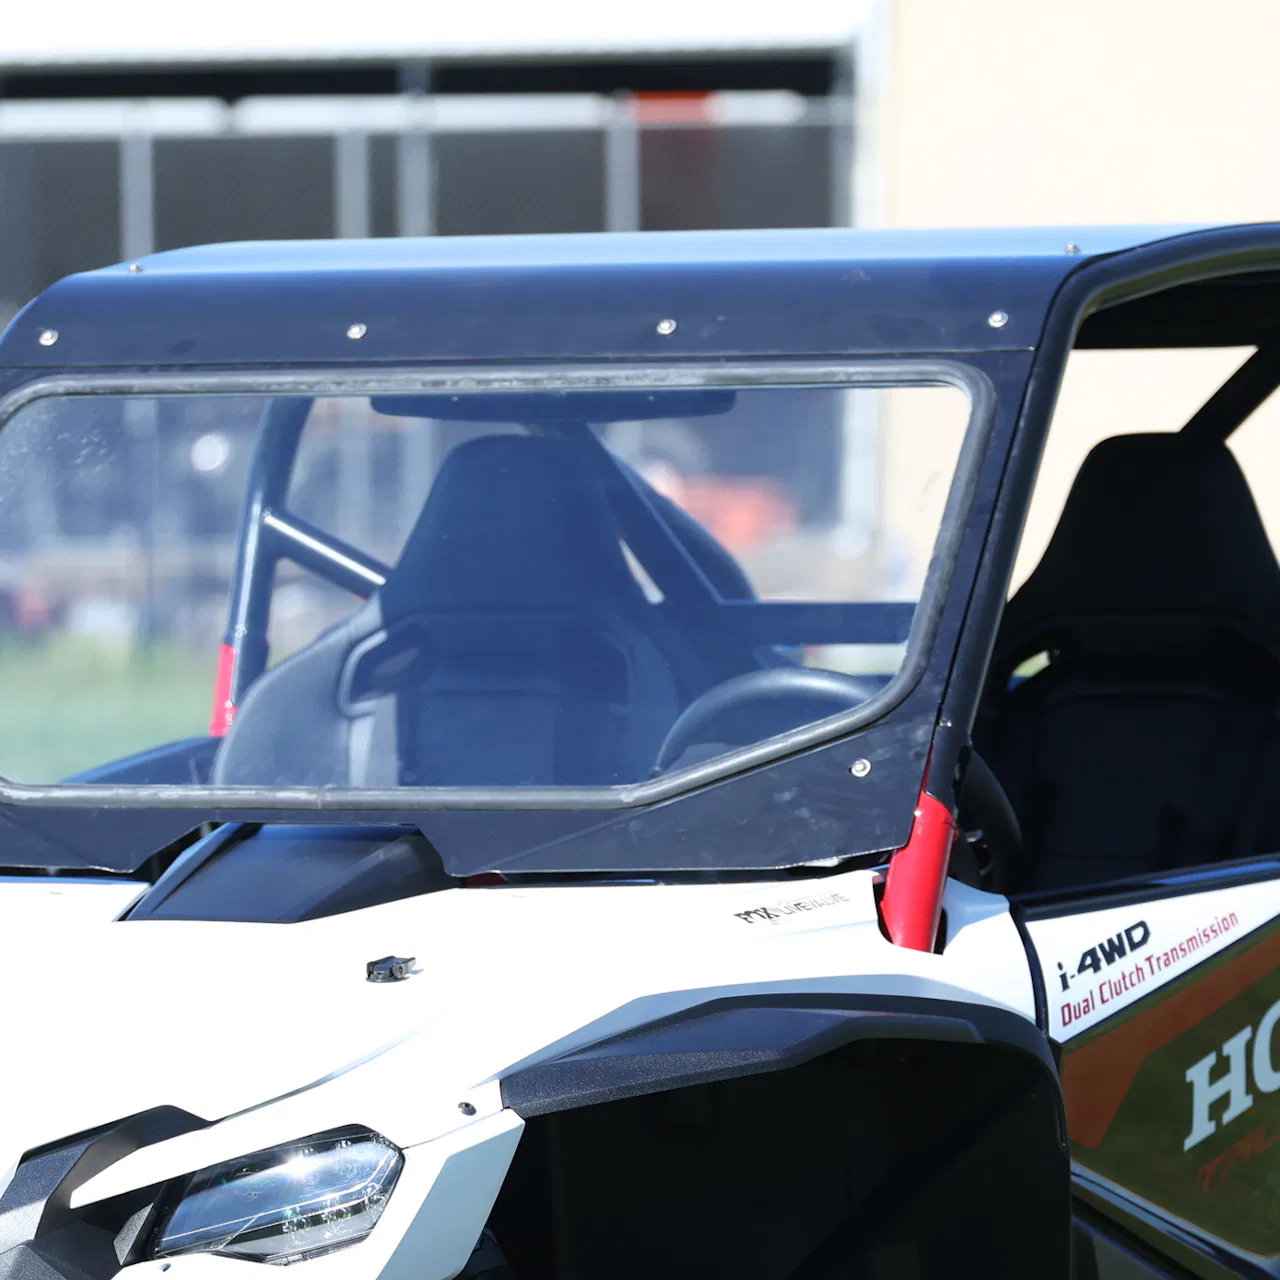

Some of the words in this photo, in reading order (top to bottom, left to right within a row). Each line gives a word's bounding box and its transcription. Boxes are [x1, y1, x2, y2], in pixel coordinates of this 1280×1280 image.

[1057, 920, 1150, 993] i-4WD
[1060, 991, 1096, 1028] Dual
[1099, 964, 1145, 1006] Clutch
[1145, 912, 1239, 976] Transmission
